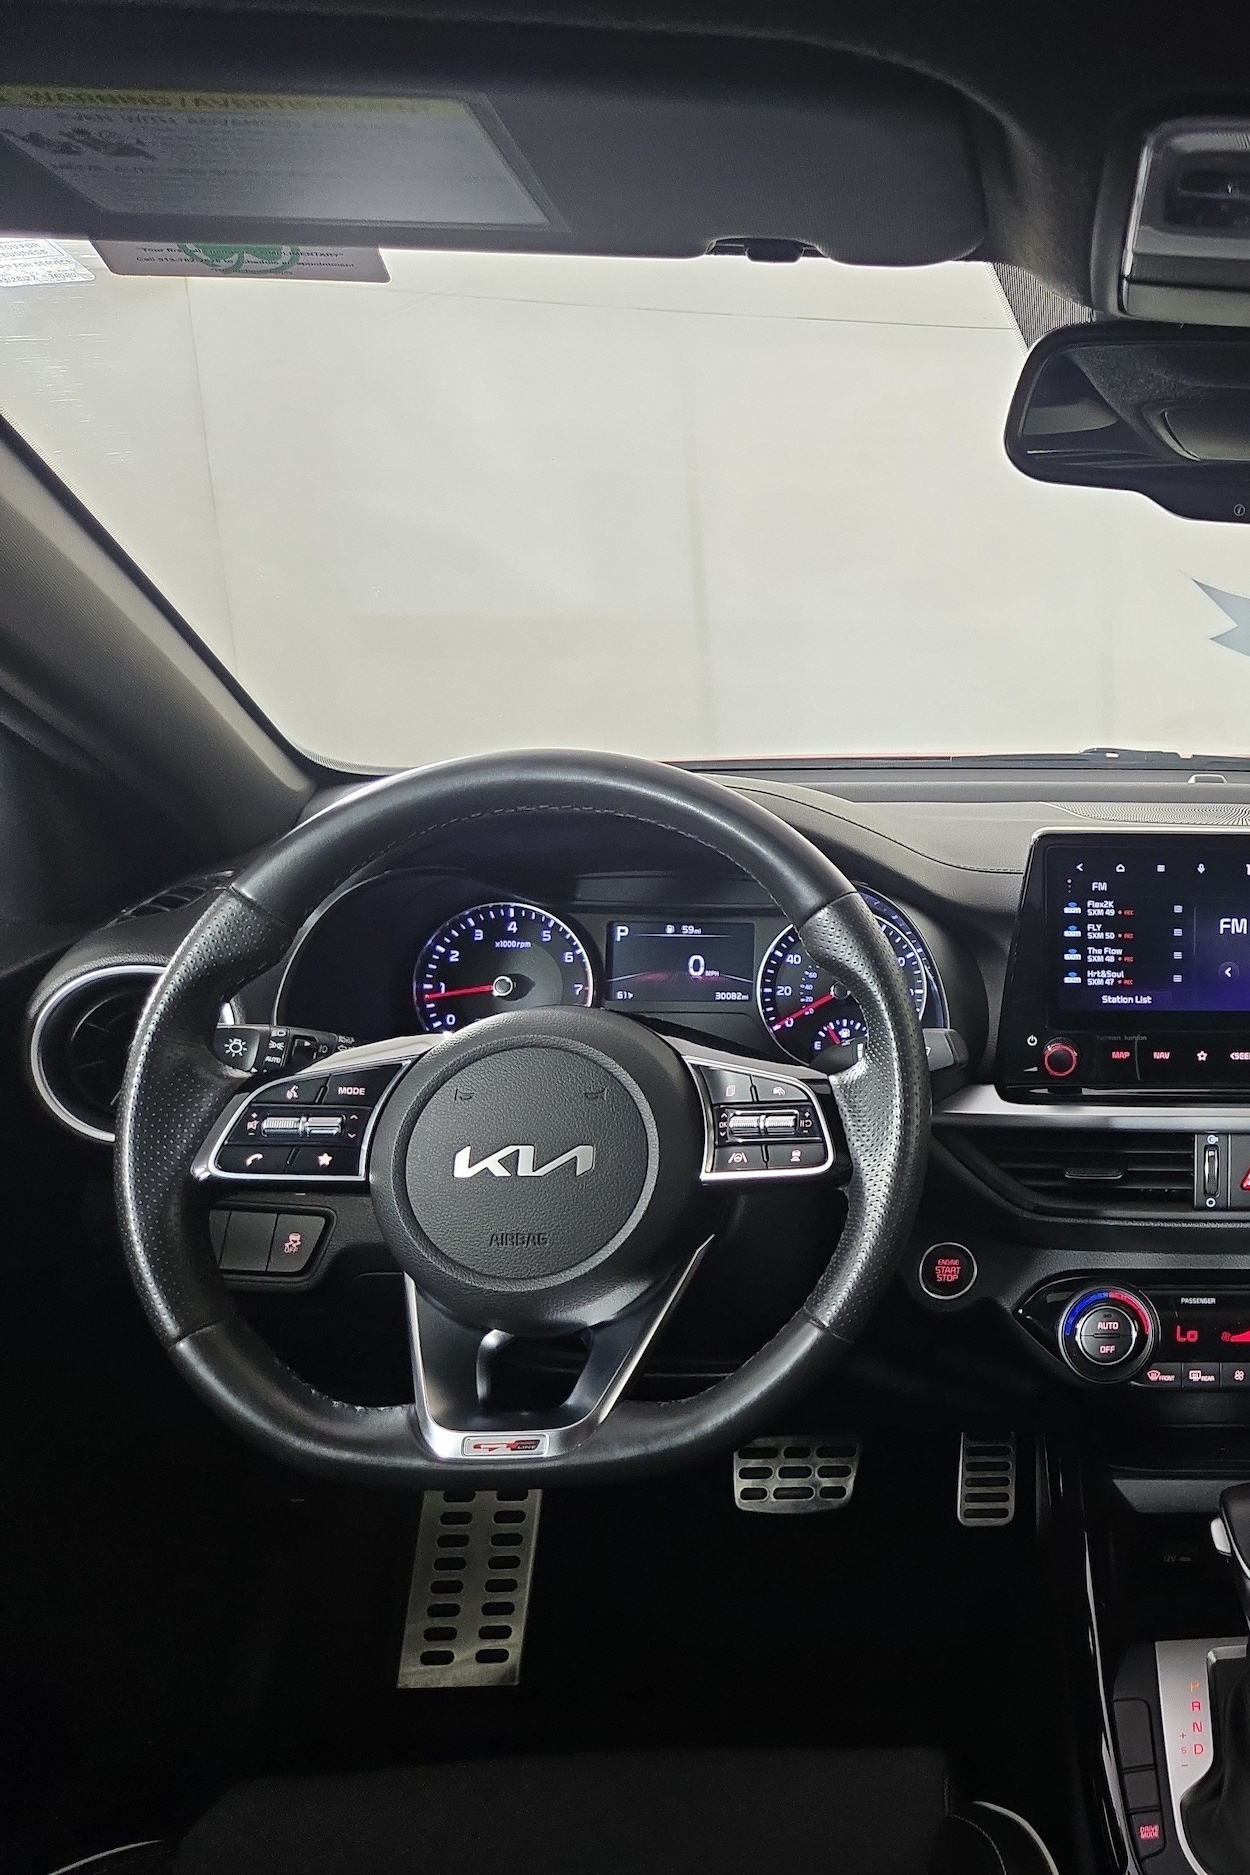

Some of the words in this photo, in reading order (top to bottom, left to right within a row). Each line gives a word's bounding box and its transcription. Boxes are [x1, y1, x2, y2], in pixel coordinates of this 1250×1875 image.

[1092, 882, 1108, 891] FM
[1087, 900, 1114, 908] Flex2K
[507, 921, 518, 934] 4
[1219, 918, 1248, 935] FM
[474, 930, 484, 941] 3
[541, 930, 551, 942] 5
[616, 926, 629, 942] P
[1087, 947, 1102, 955] The
[1104, 947, 1123, 955] Flow
[449, 951, 460, 962] 2
[564, 952, 574, 963] 6
[786, 955, 802, 965] 40
[688, 954, 706, 977] 0
[1087, 970, 1124, 978] Hrt&Soul
[1087, 978, 1104, 986] SXM
[1105, 978, 1114, 986] 47
[440, 981, 446, 994] 1
[573, 984, 583, 996] 7
[776, 985, 792, 996] 20
[1102, 995, 1134, 1004] Station
[1135, 995, 1152, 1004] List
[446, 1013, 456, 1026] 0
[785, 1017, 794, 1027] 0
[814, 1041, 822, 1050] E
[264, 1055, 281, 1064] AUTO
[1112, 1051, 1130, 1059] MAP
[1153, 1051, 1170, 1060] NAV
[338, 1086, 365, 1096] MODE
[453, 1145, 595, 1178] KIA
[489, 1232, 549, 1248] AIRBAG
[935, 1266, 961, 1274] START
[936, 1274, 959, 1282] STOP
[1097, 1321, 1119, 1330] AUTO
[1176, 1325, 1199, 1342] Lo
[1100, 1345, 1116, 1354] OFF
[1190, 1681, 1199, 1692] P
[1191, 1701, 1201, 1712] R
[1192, 1721, 1203, 1733] N
[1181, 1747, 1187, 1755] S
[1194, 1743, 1204, 1755] D
[1139, 1824, 1159, 1833] DRIVE
[1140, 1832, 1159, 1840] MODE
